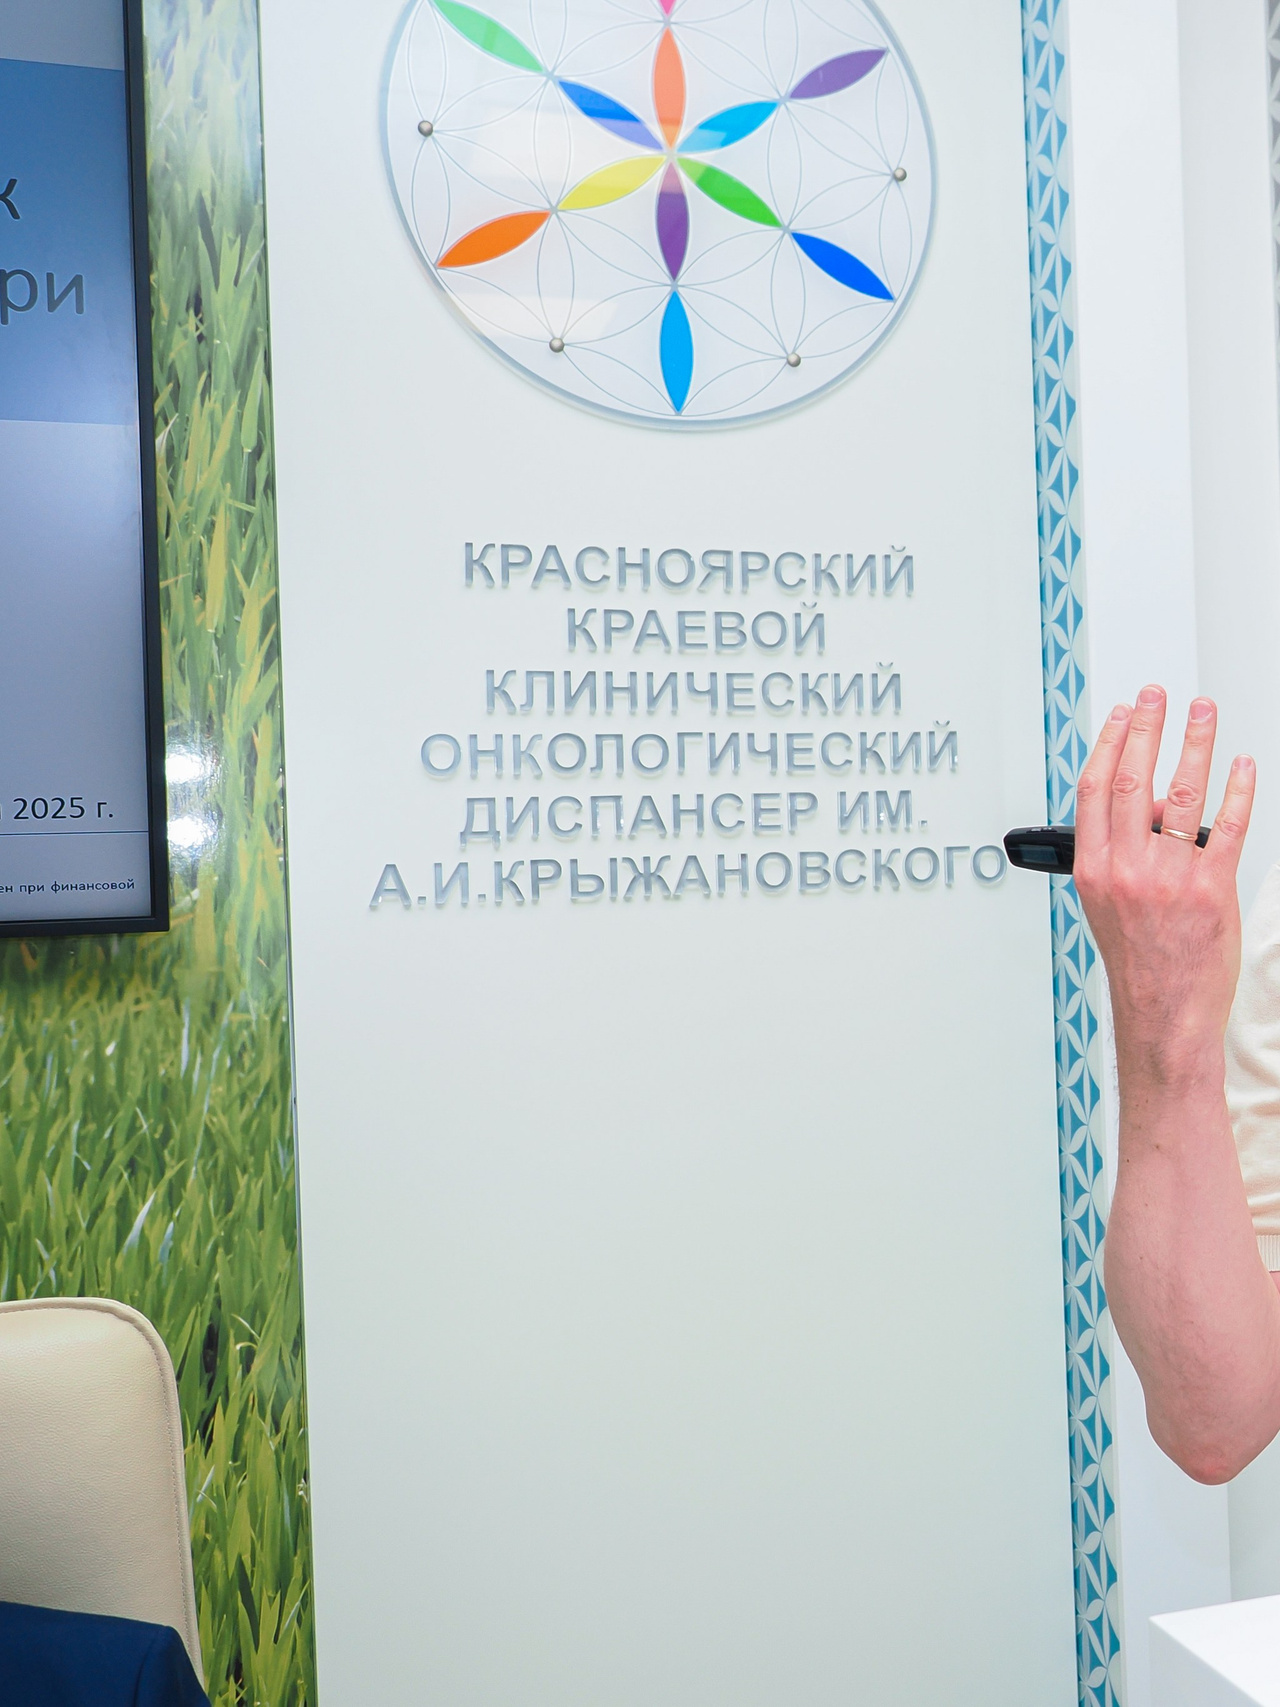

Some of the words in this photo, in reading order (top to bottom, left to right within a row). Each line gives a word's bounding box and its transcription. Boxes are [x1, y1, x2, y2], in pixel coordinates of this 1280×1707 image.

[0, 269, 84, 325] ри
[464, 542, 915, 597] КРАСНОЯРСКИЙ
[566, 601, 826, 655] КРАЕВОЙ
[485, 661, 902, 715] КЛИНИЧЕСКИЙ
[420, 720, 959, 779] ОНКОЛОГИЧЕСКИЙ
[13, 797, 85, 820] 2025
[97, 802, 114, 818] г.
[460, 791, 819, 849] ДИСПАНСЕР
[836, 789, 929, 834] ИМ.
[19, 884, 45, 895] при
[51, 878, 135, 894] финансовой
[368, 844, 1008, 910] А.И.КРЫЖАНОВСКОГО
